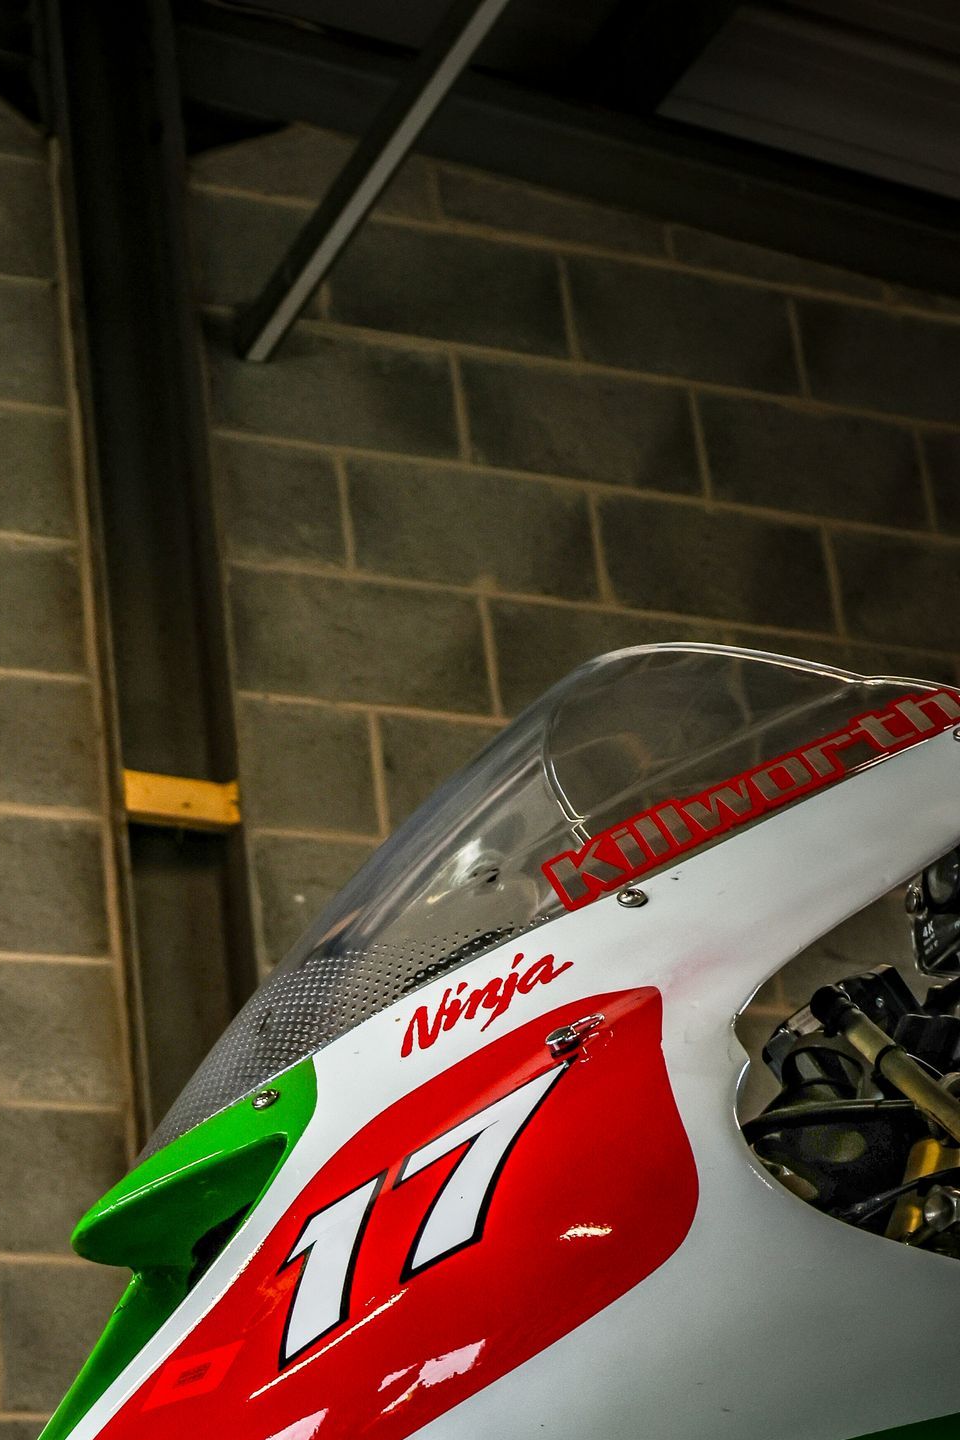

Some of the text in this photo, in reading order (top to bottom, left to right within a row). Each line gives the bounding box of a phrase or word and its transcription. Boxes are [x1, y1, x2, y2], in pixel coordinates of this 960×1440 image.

[546, 688, 960, 906] Killworth
[400, 952, 575, 1059] Ninja
[278, 1053, 580, 1373] 17
